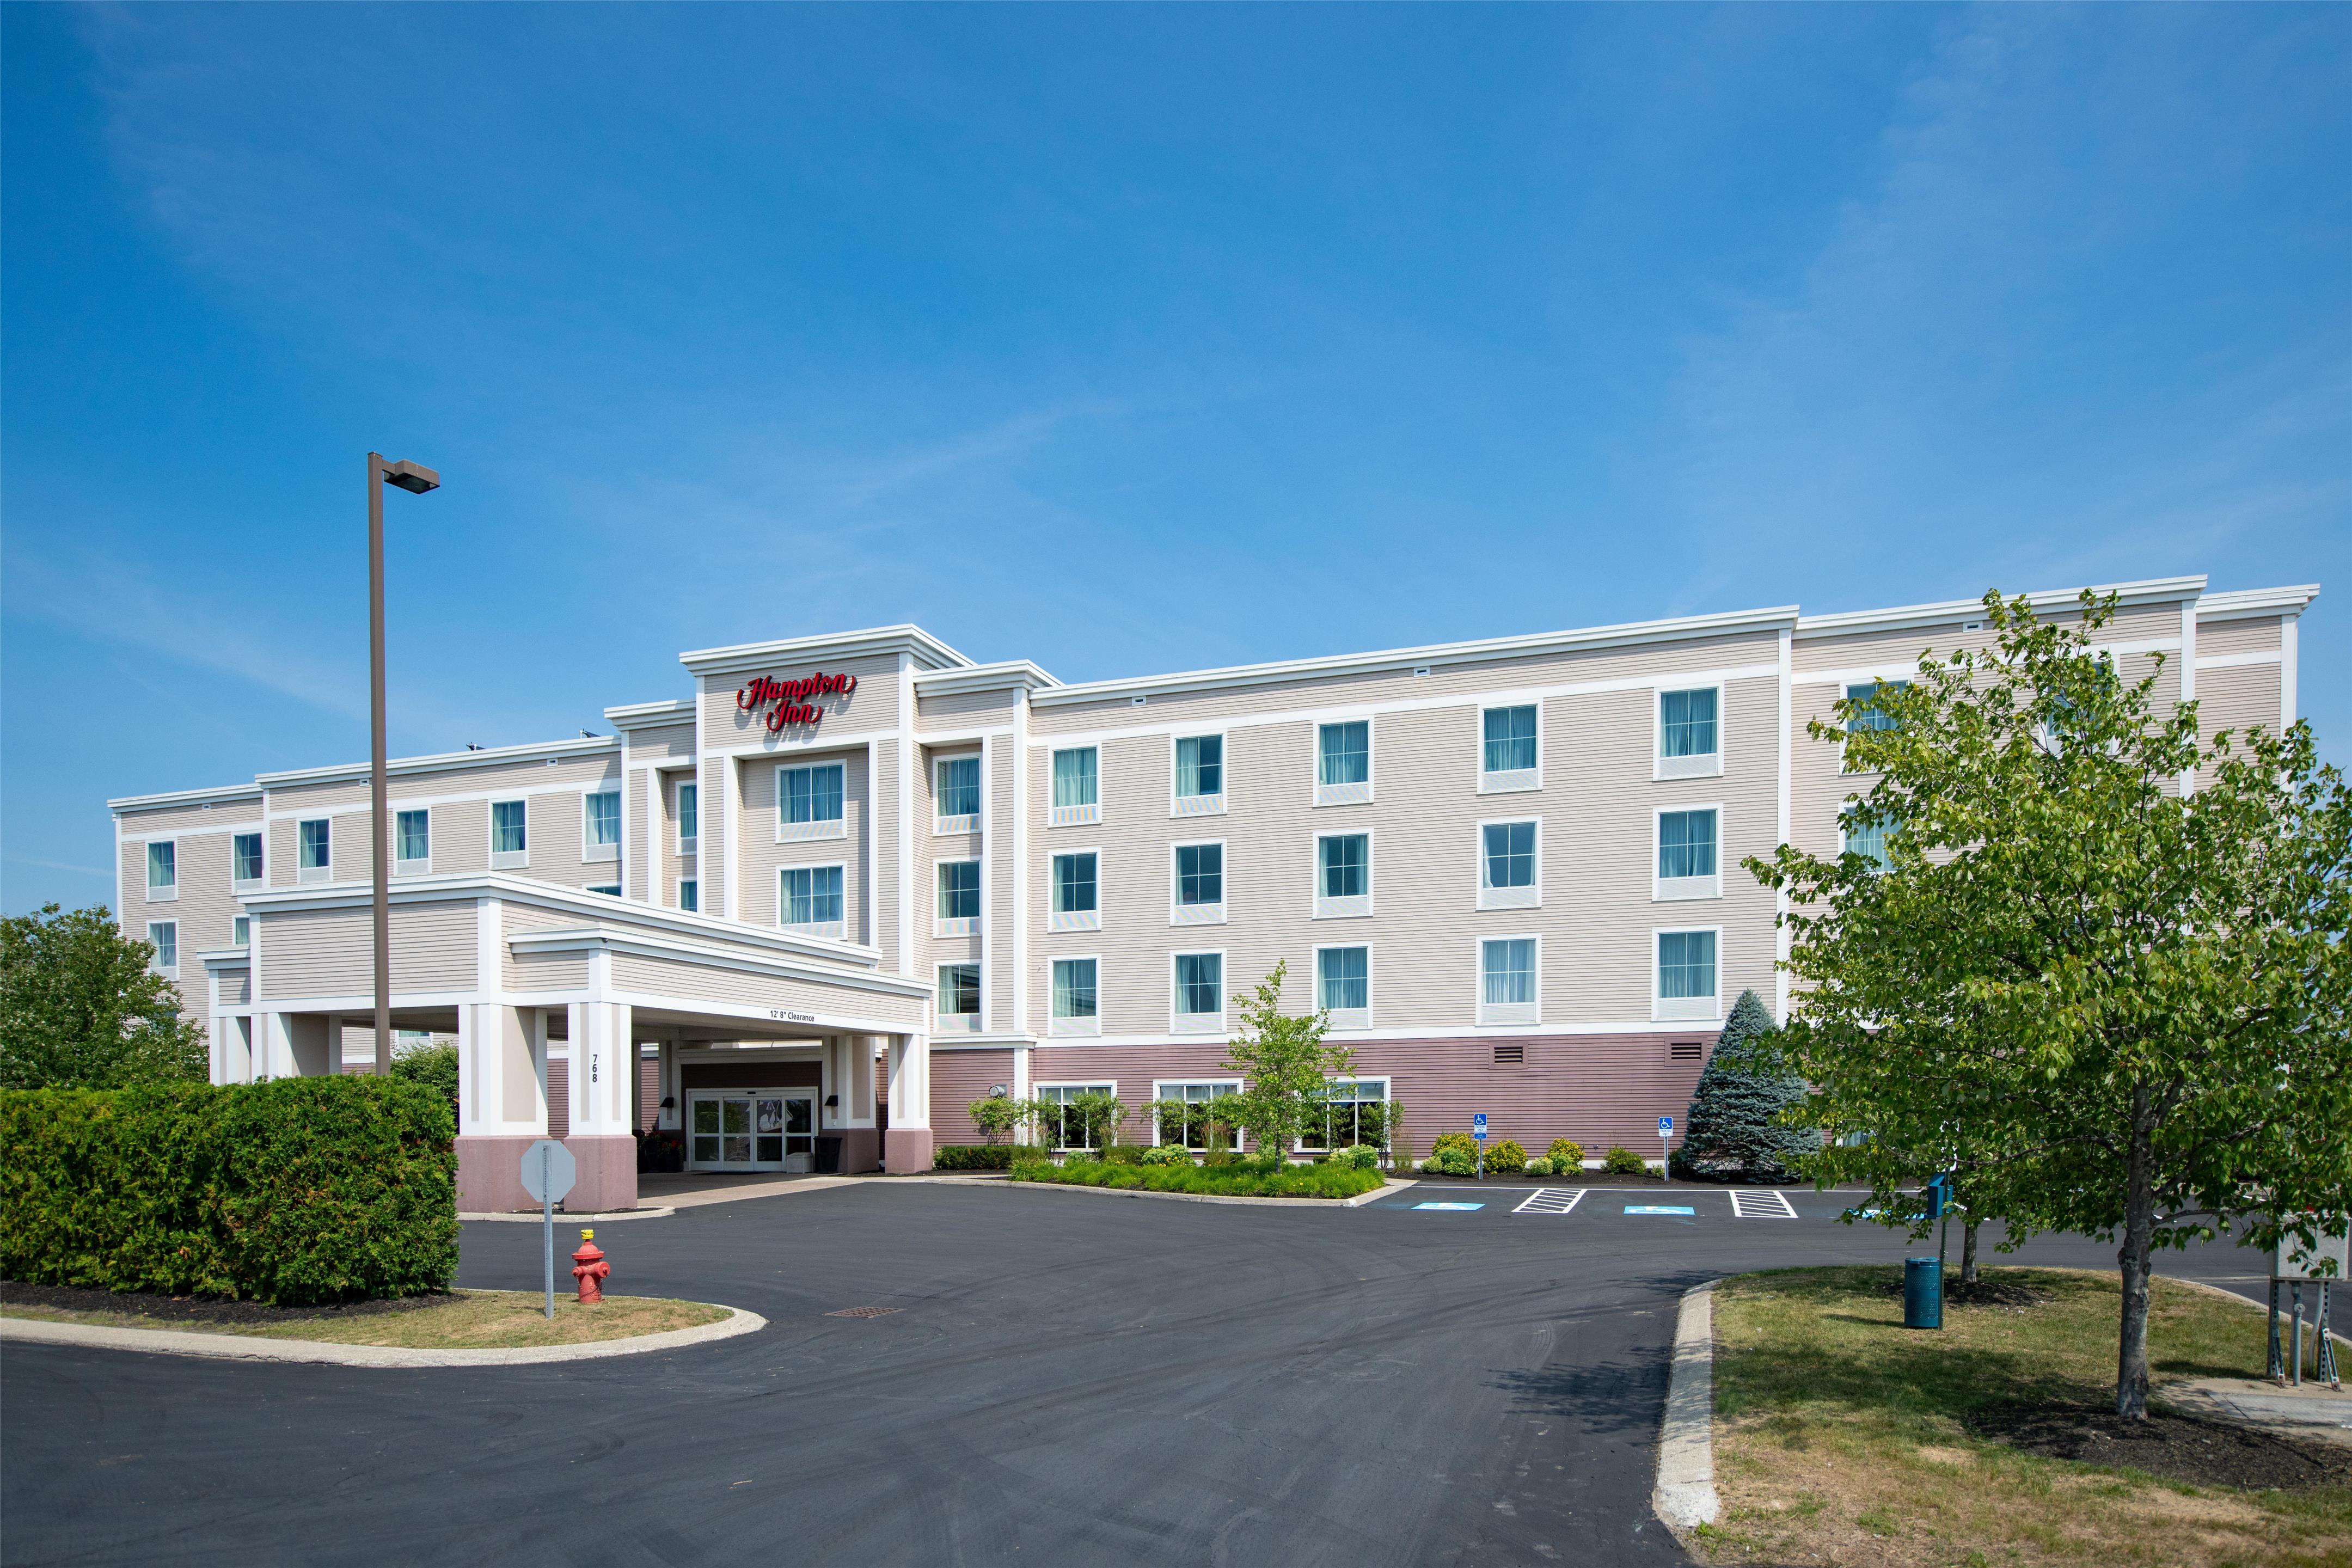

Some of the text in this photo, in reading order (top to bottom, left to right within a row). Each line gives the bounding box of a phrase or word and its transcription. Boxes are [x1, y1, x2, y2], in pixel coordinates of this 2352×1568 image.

[737, 672, 857, 709] Hampton
[766, 700, 823, 732] Inn
[788, 1012, 814, 1021] Clearance
